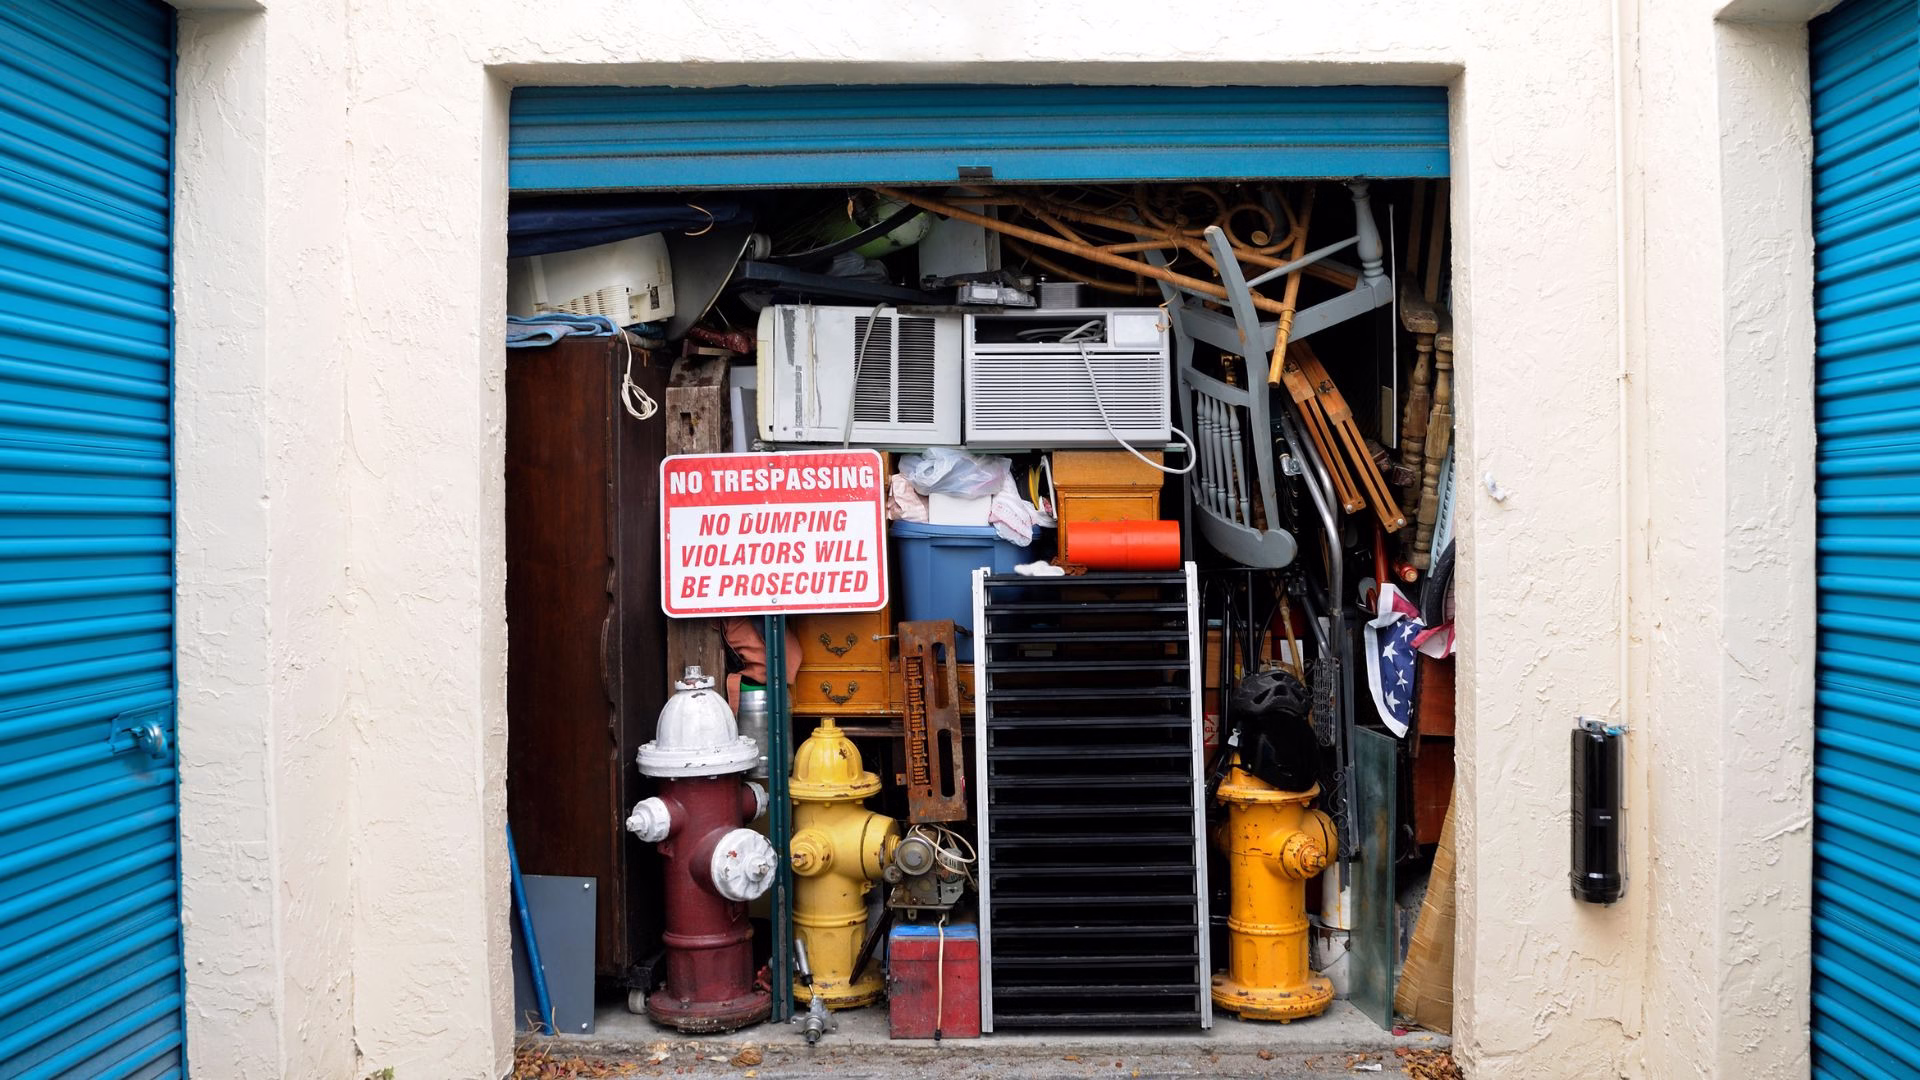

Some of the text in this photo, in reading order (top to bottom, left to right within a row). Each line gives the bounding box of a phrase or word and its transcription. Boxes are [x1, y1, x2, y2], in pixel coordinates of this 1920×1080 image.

[670, 465, 874, 495] NO TRESPASSING
[699, 509, 848, 536] NO DUMPING
[681, 539, 868, 567] VIOLATORS WILL
[680, 570, 869, 599] BE PROSECUTED
